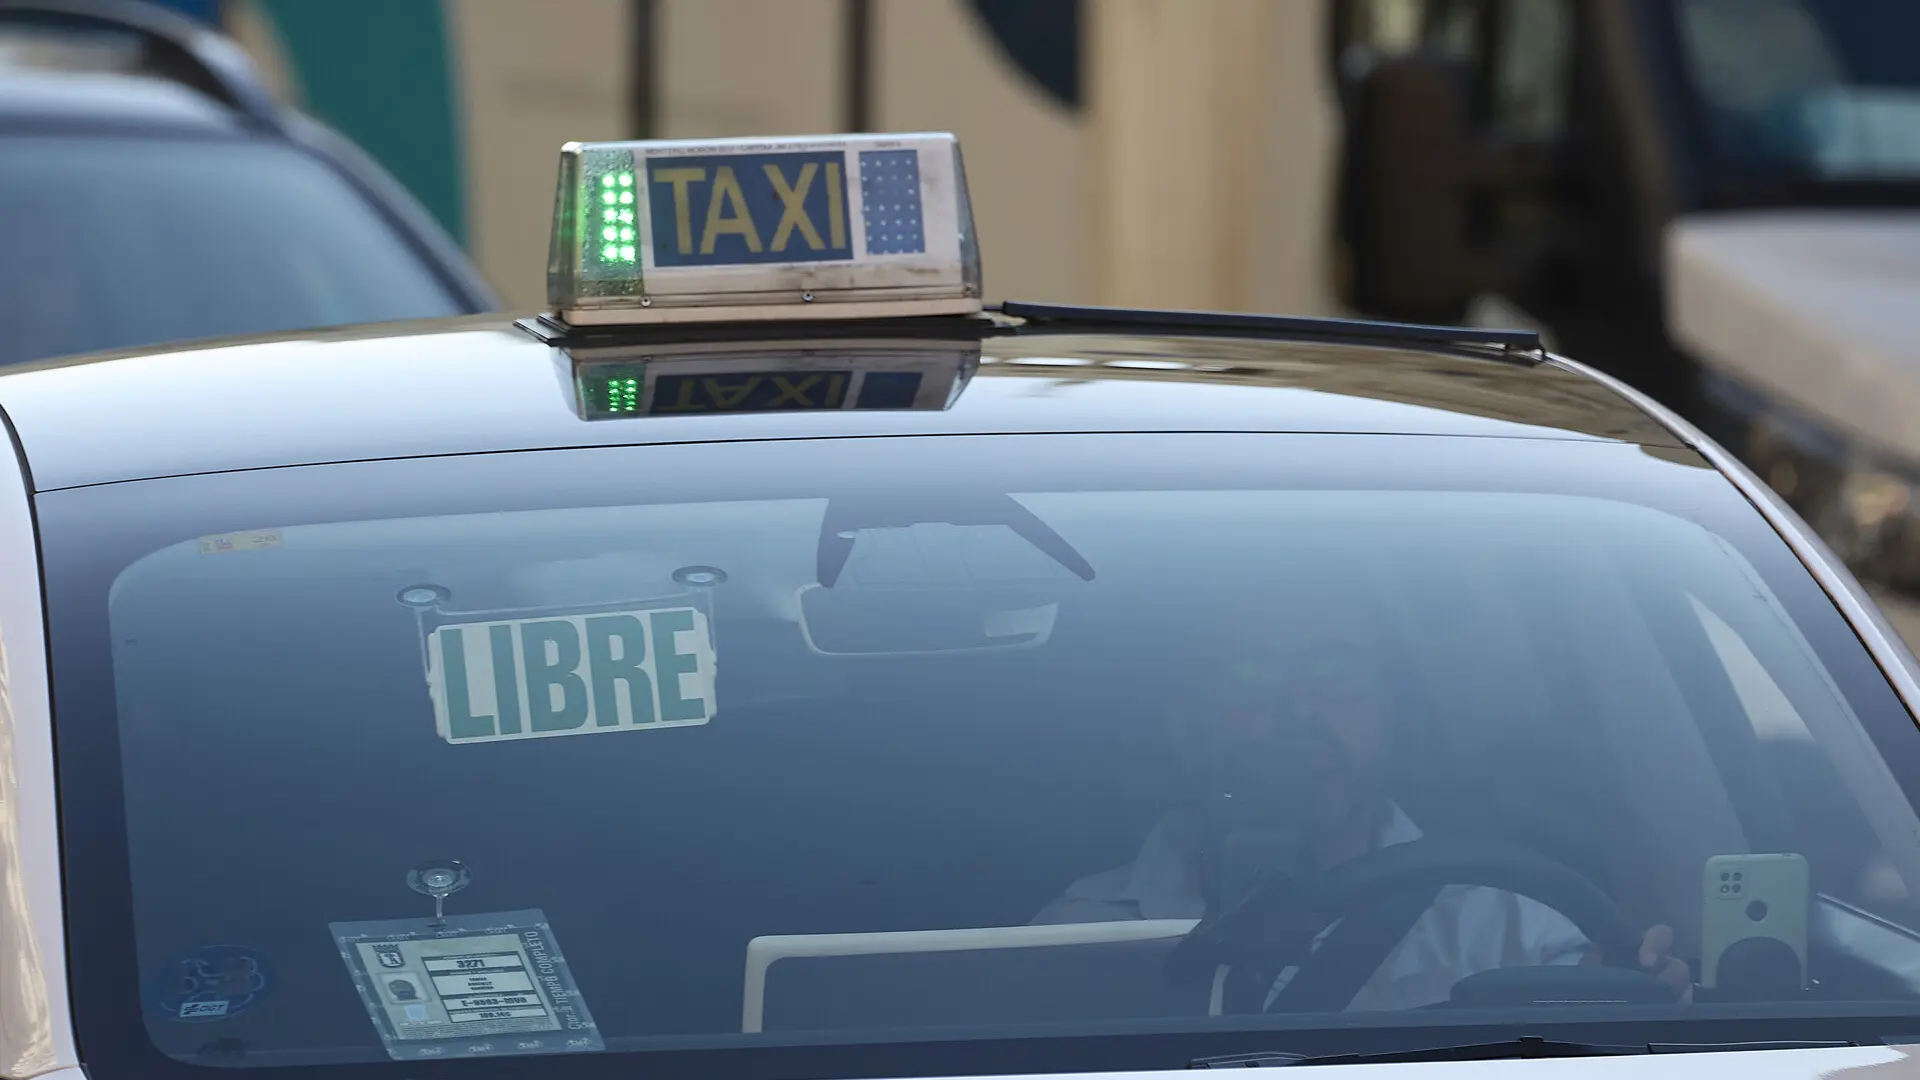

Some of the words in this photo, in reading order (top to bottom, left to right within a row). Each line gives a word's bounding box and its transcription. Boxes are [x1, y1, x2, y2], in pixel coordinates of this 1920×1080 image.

[653, 162, 845, 254] TAXI
[440, 610, 705, 739] LIBRE
[456, 959, 485, 968] 3271
[525, 931, 554, 974] COMPLETO
[544, 975, 569, 1004] TIEMPO
